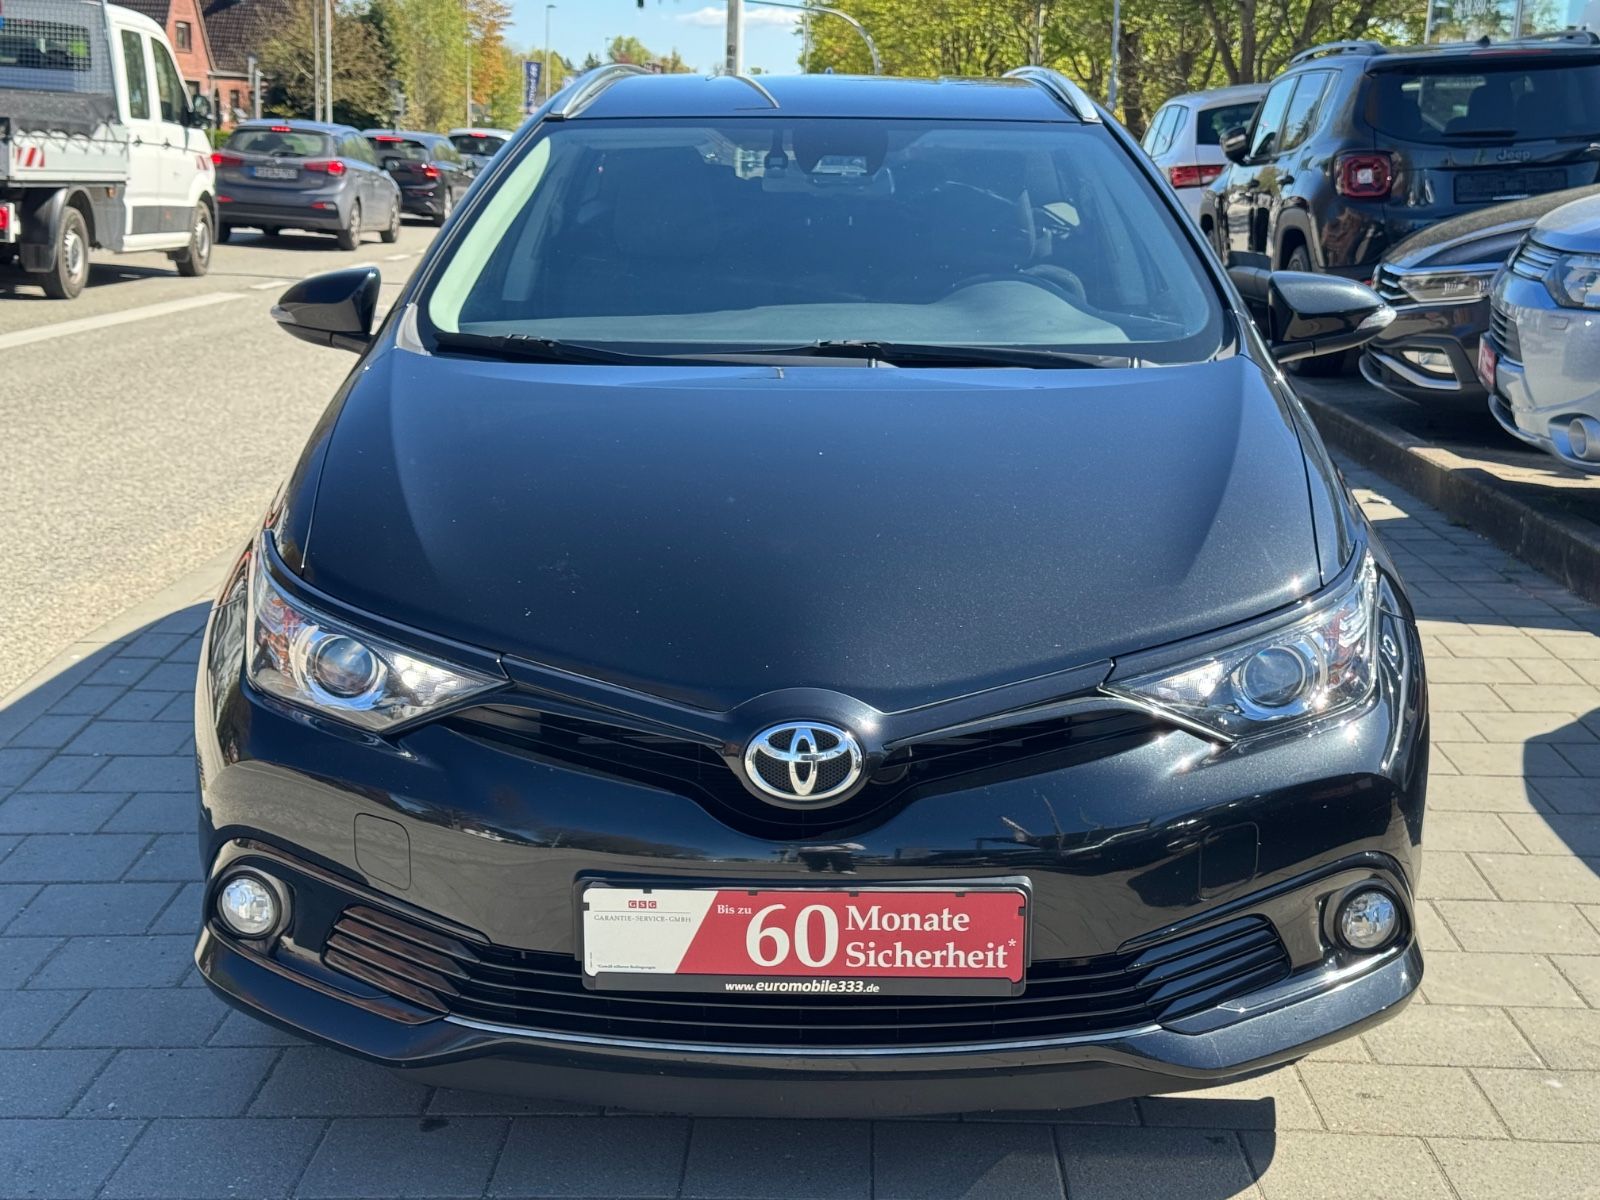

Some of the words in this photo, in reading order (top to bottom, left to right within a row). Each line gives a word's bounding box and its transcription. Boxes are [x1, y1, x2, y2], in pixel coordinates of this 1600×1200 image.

[1497, 149, 1530, 161] Jeep
[628, 900, 657, 909] GSG
[717, 904, 735, 914] Bis
[737, 906, 752, 915] zu
[845, 905, 970, 932] Monate
[746, 904, 839, 968] 60
[725, 979, 880, 993] www.euromobile333.de
